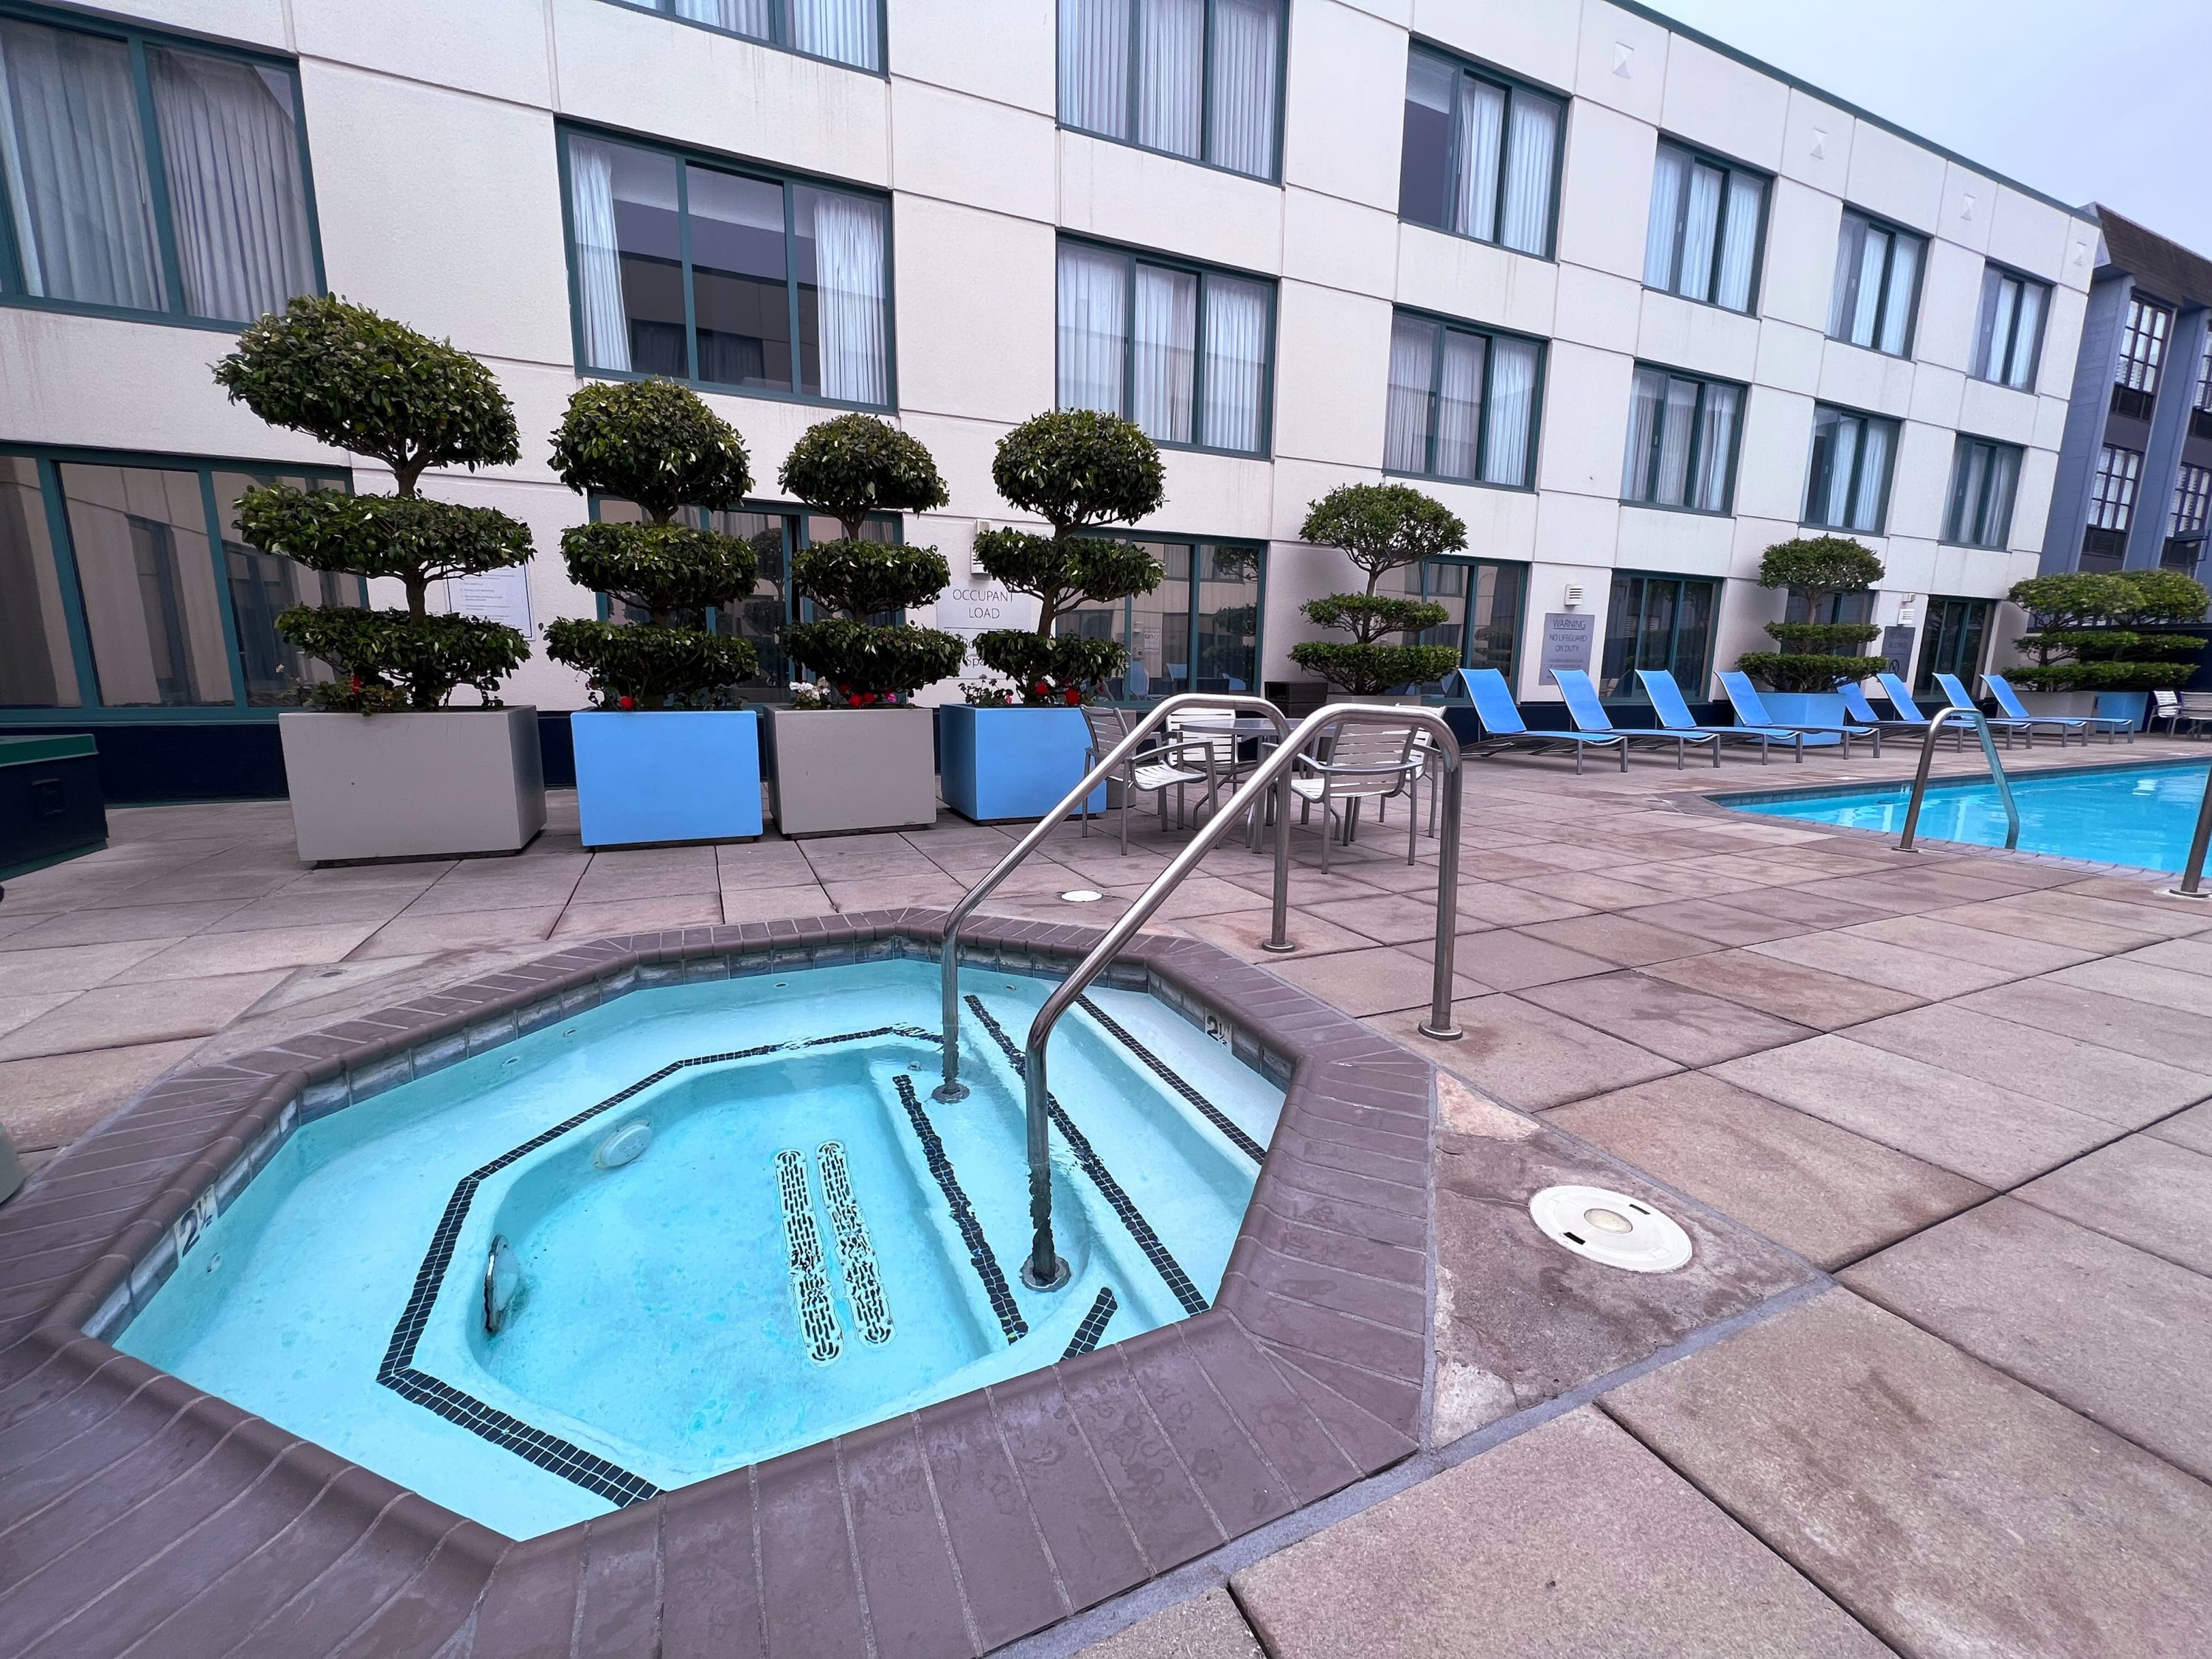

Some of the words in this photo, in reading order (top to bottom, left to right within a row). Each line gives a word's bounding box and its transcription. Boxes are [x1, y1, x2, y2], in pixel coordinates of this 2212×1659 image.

[953, 589, 1013, 602] OCCUPANT
[969, 607, 1000, 619] LOAD
[1553, 619, 1586, 630] WARNING
[1549, 633, 1558, 641] NO
[1559, 633, 1587, 642] LIFEGUARD
[1555, 644, 1563, 653] ON
[1564, 644, 1579, 653] DUTY
